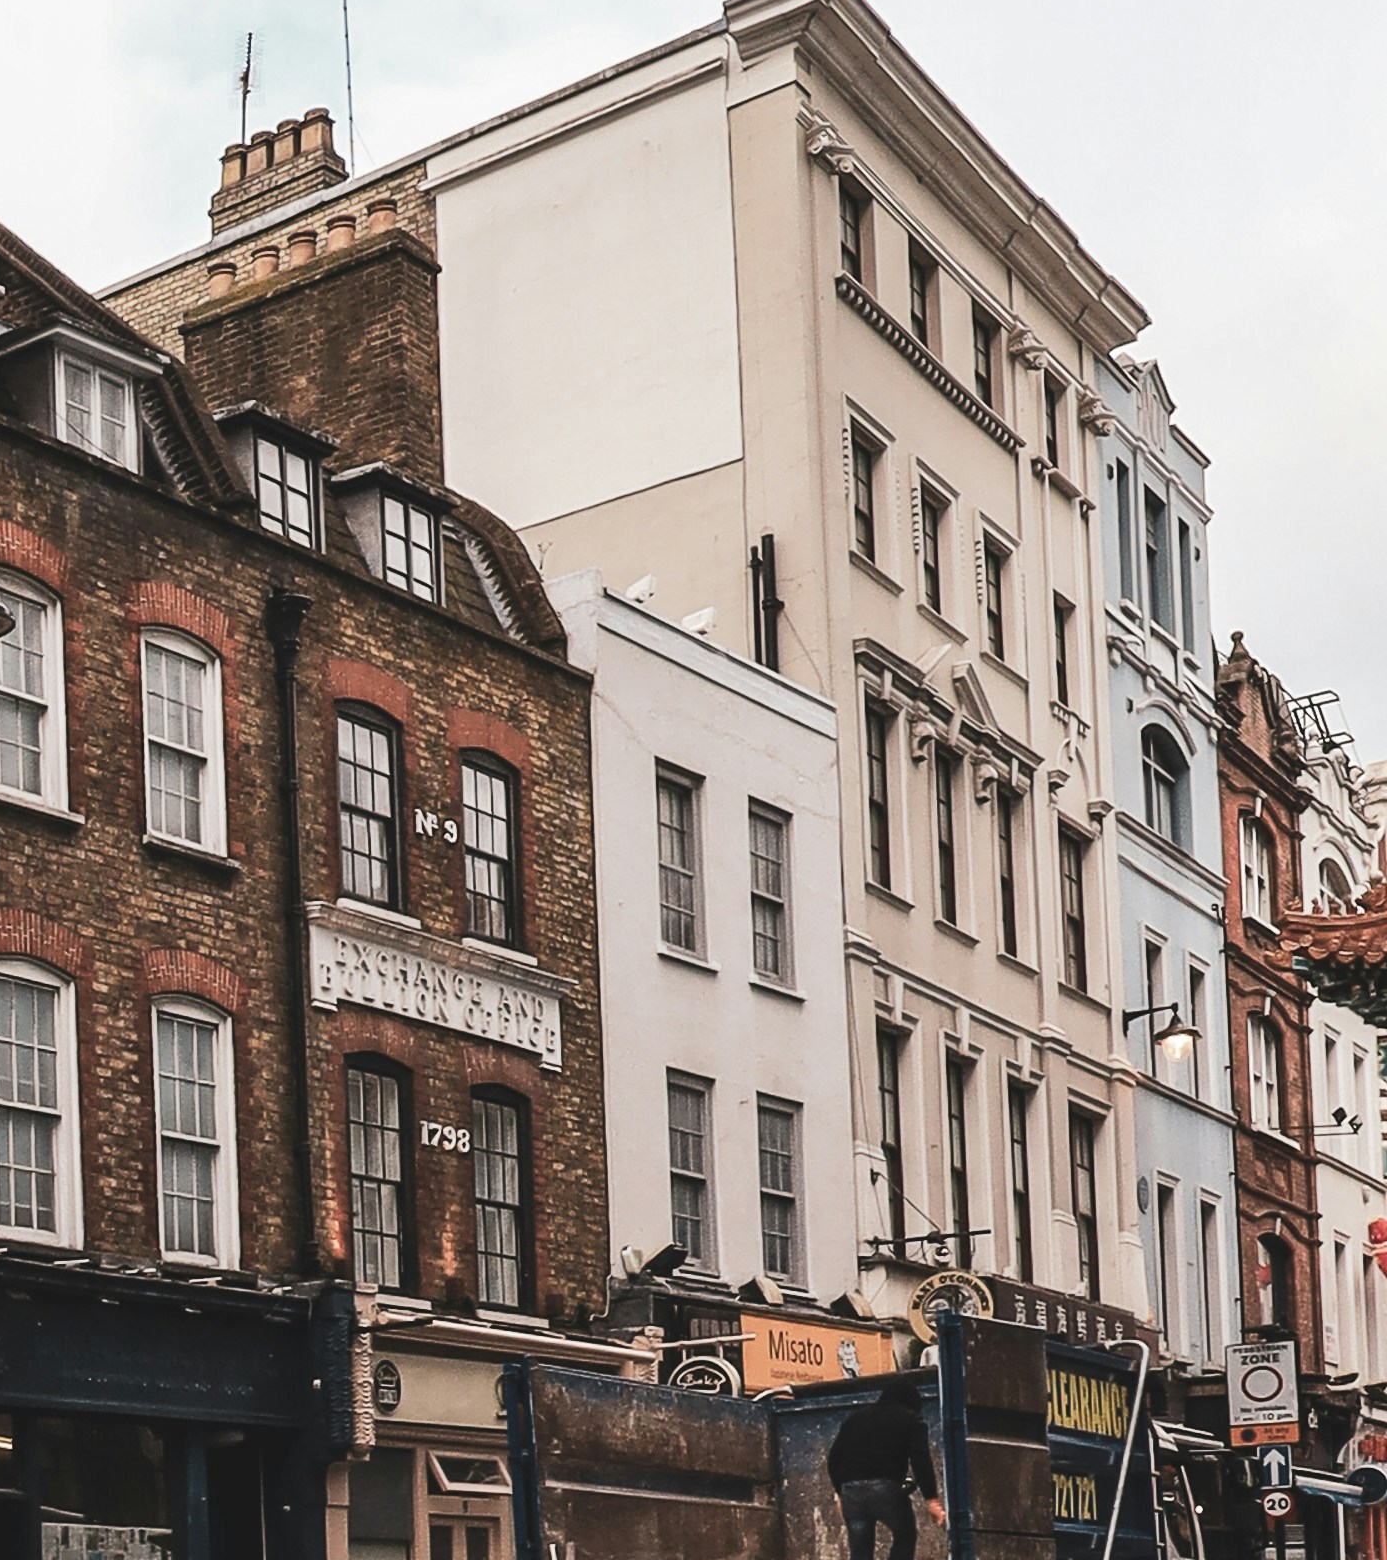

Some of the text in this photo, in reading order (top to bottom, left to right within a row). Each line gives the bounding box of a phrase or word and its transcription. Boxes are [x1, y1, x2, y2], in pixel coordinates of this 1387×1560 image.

[443, 820, 458, 844] 9
[334, 937, 547, 1023] EXCHANGE AND
[320, 962, 556, 1053] BULLION OFFICE
[420, 1120, 471, 1152] 1798
[768, 1329, 824, 1366] Misato
[1240, 1353, 1280, 1366] ZONE
[1266, 1497, 1289, 1511] 20
